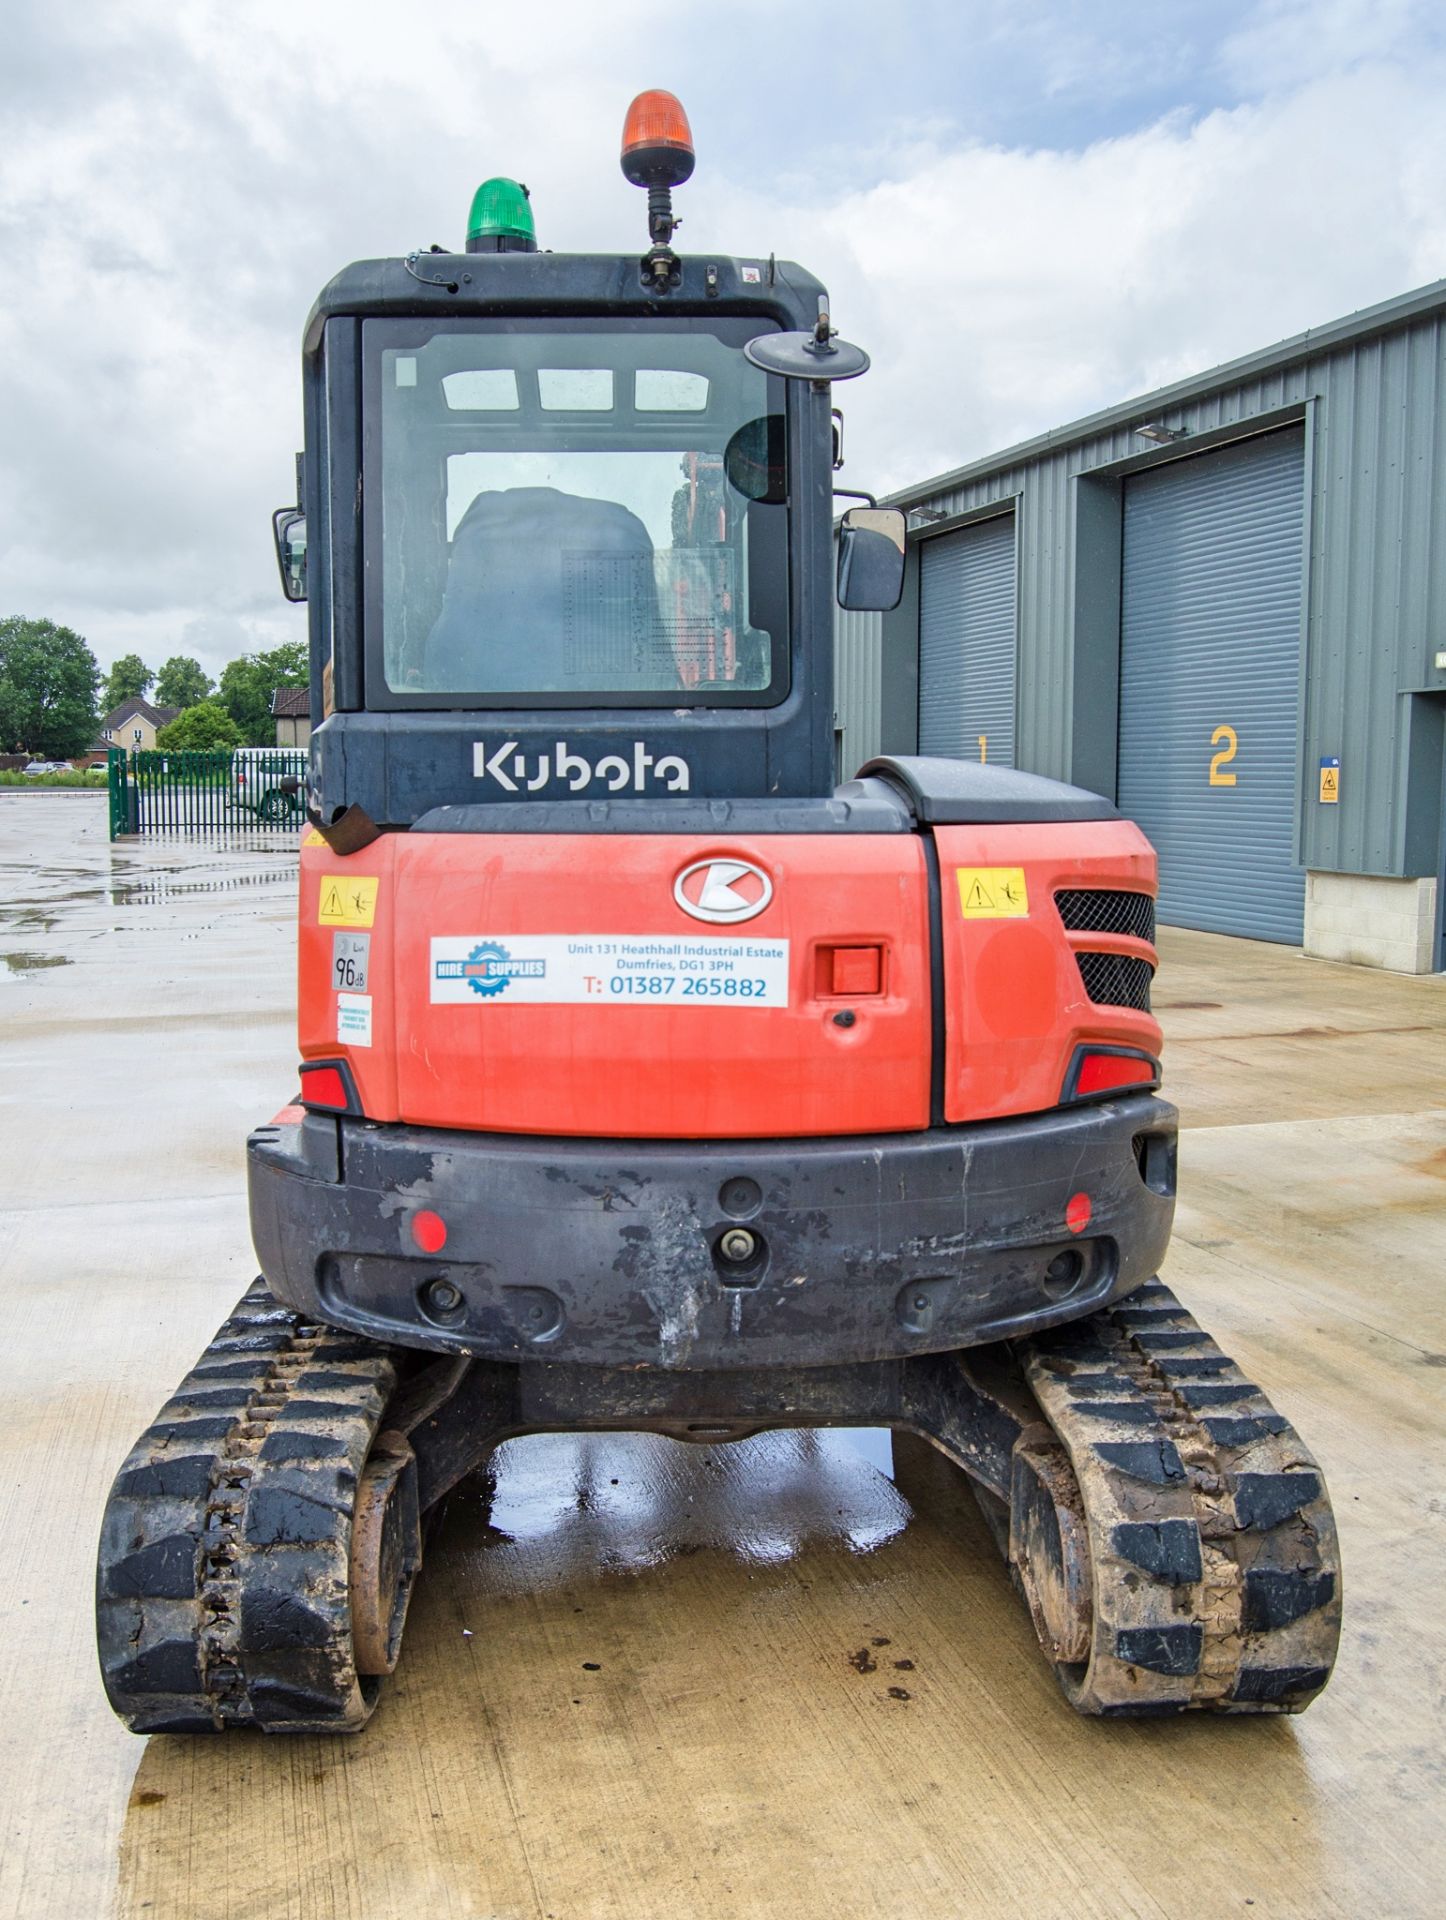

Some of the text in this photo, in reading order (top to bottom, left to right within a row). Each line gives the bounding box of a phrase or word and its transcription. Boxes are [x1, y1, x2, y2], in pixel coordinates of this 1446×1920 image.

[978, 735, 987, 765] 1
[1209, 724, 1238, 787] 2
[472, 741, 690, 792] Kubota
[567, 943, 784, 959] Unit 131 Heathhall Industrial Estate
[437, 962, 463, 977] HIRE
[488, 961, 544, 977] SUPPLIES
[616, 958, 734, 972] Dumfries, DG1 3PH
[583, 976, 767, 998] T: 01387 265882
